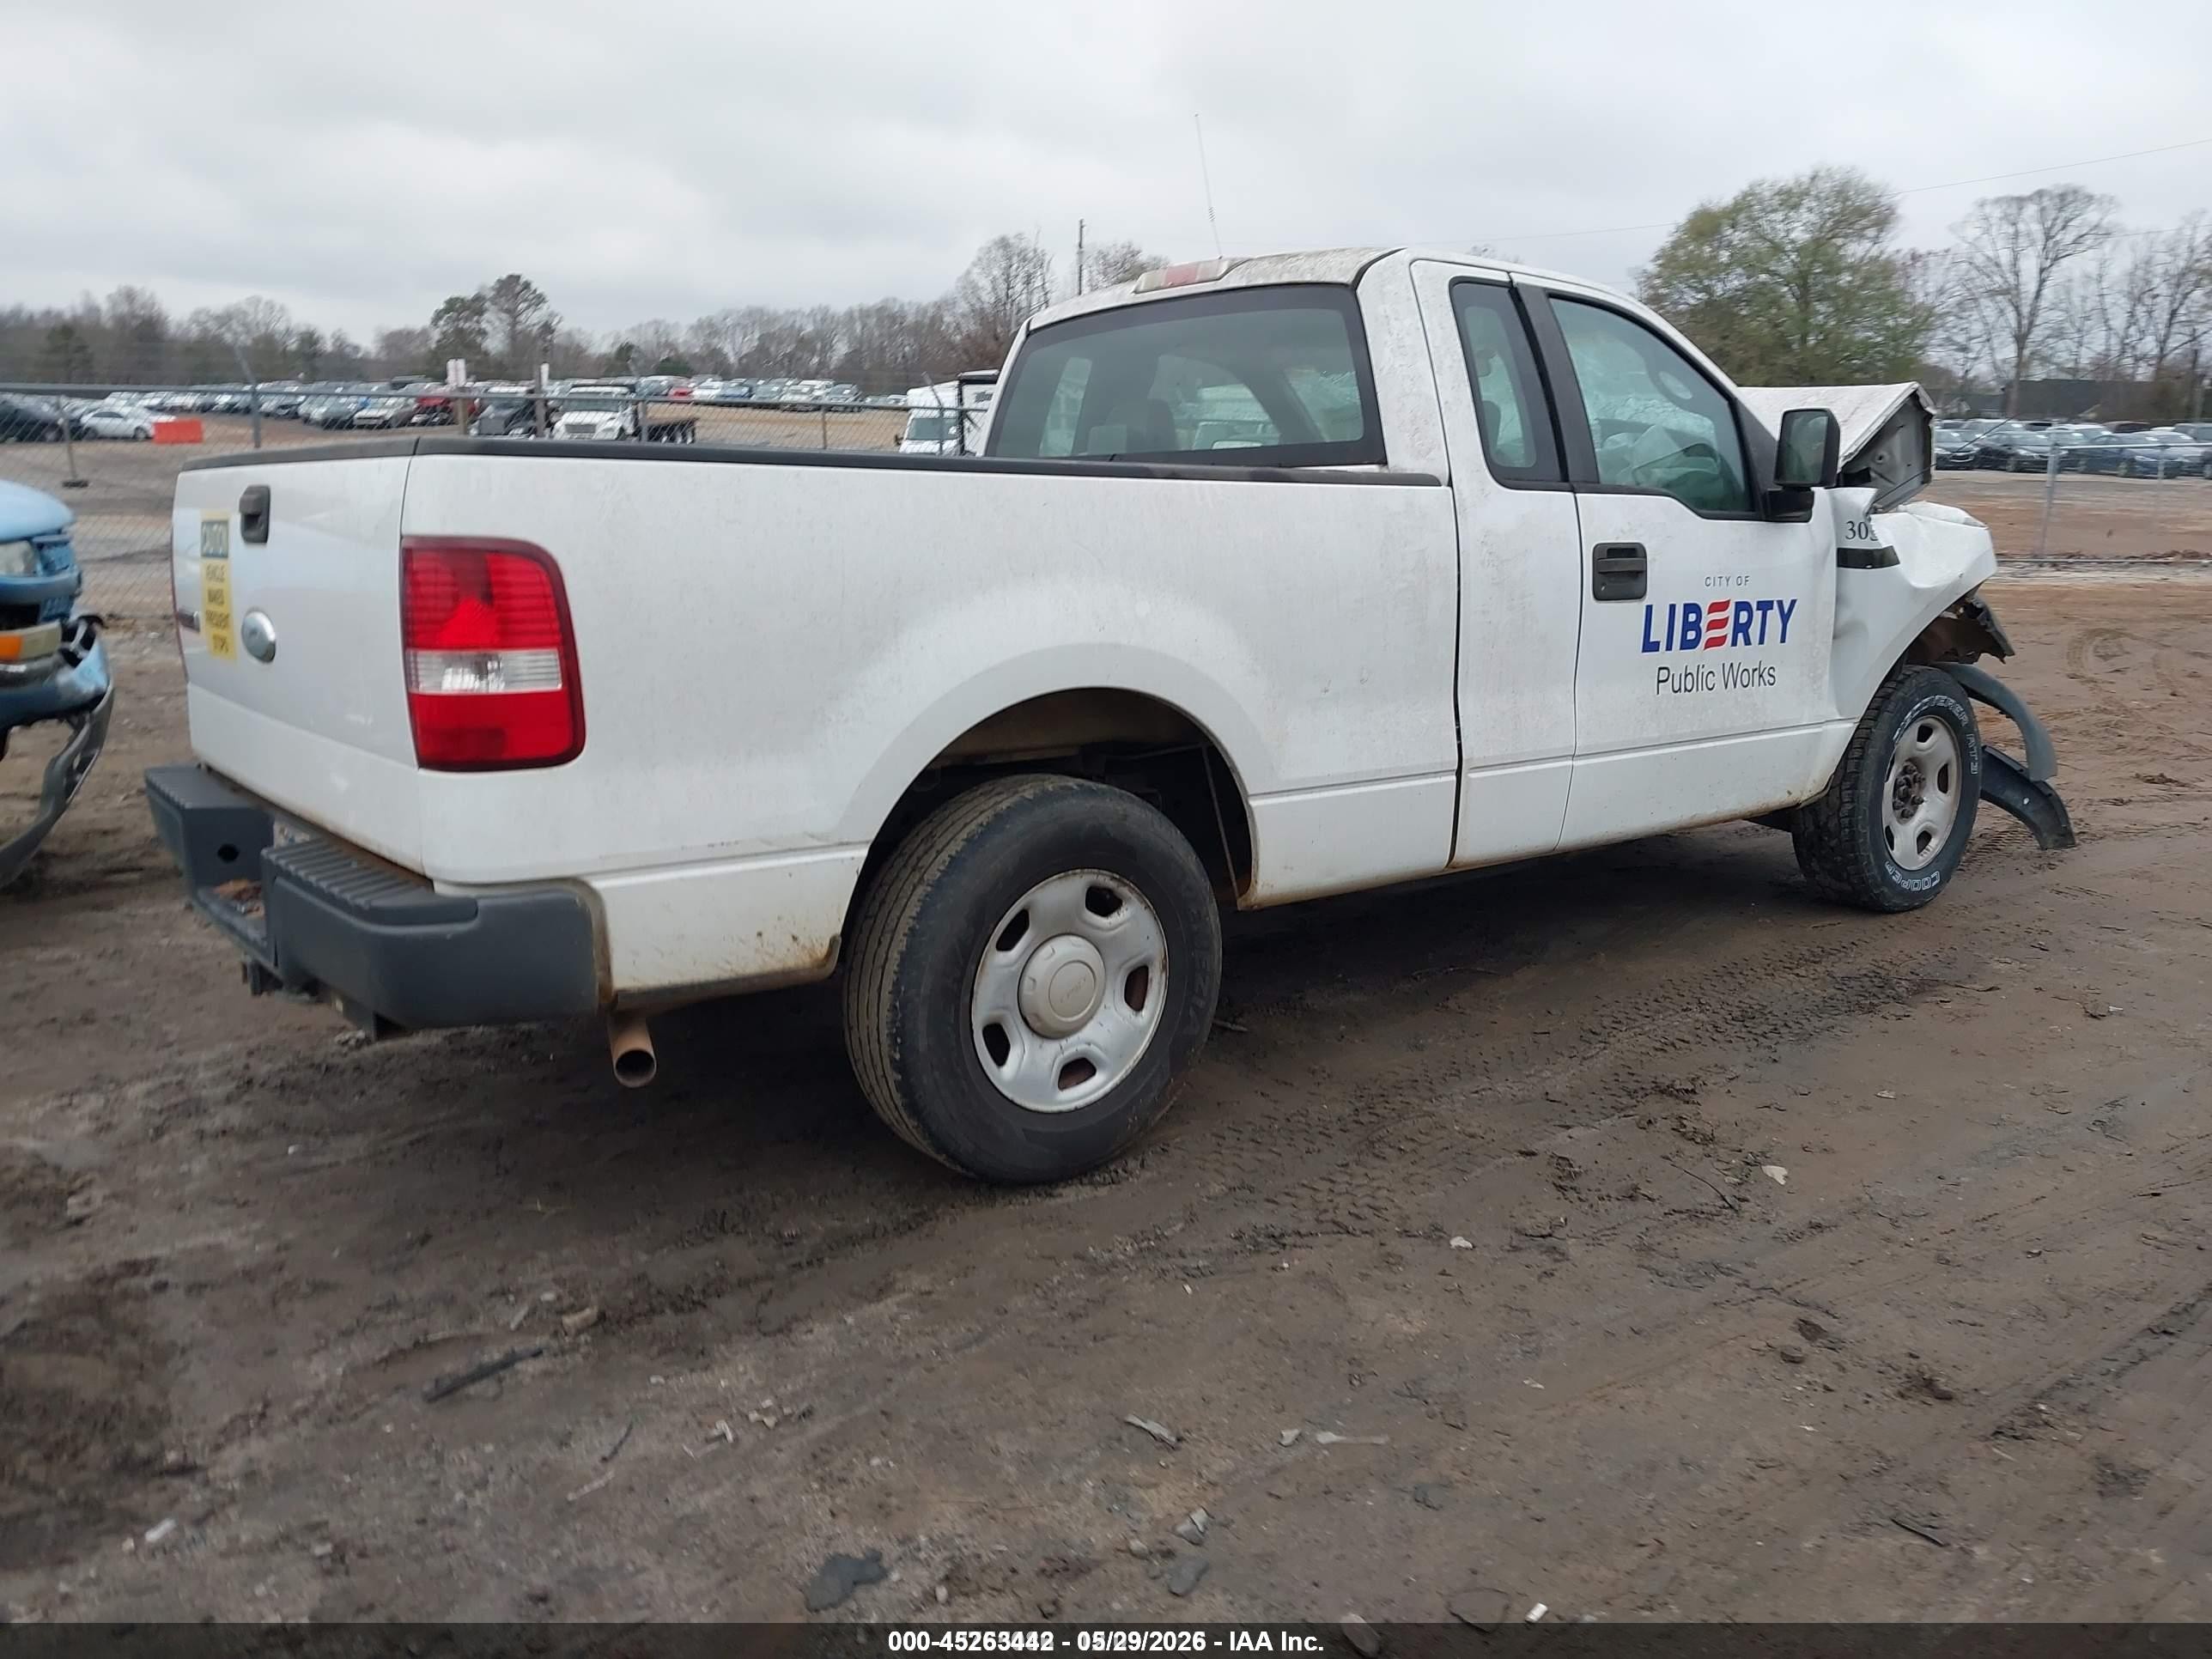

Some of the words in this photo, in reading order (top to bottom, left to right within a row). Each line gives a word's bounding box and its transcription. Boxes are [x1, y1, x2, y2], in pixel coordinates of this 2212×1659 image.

[1705, 575, 1731, 586] CITY
[1735, 575, 1750, 586] OF
[1641, 599, 1797, 653] LIBERTY
[1656, 664, 1716, 696] Public
[1721, 660, 1777, 690] Works
